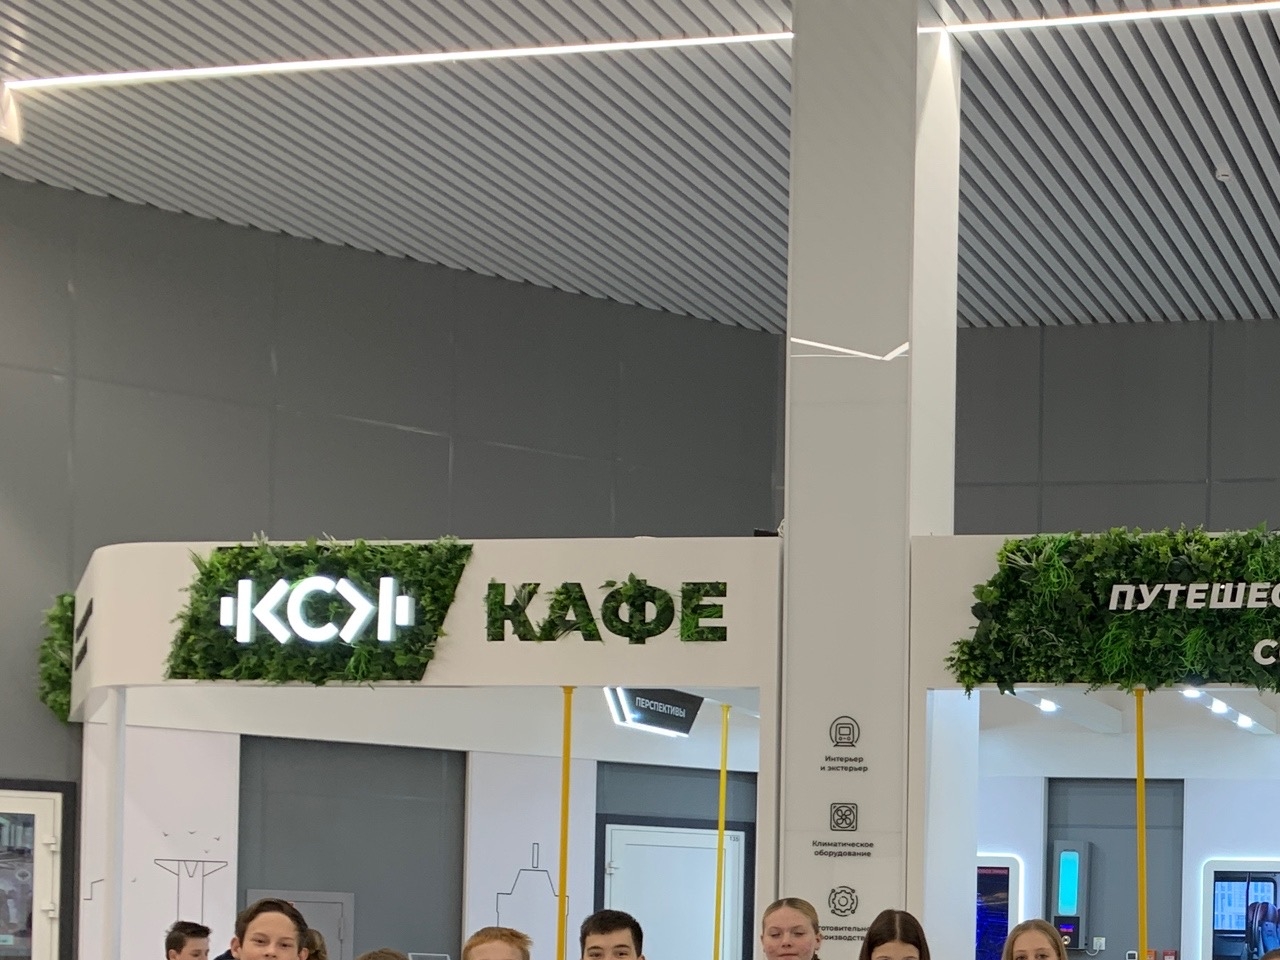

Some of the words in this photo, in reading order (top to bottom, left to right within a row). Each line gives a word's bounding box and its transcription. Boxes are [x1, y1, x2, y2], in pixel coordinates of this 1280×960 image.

[485, 579, 727, 644] КАФЕ
[635, 697, 686, 717] ПЕРСПЕКТИВЫ
[812, 840, 874, 848] Климатическое
[814, 850, 871, 858] оборудование
